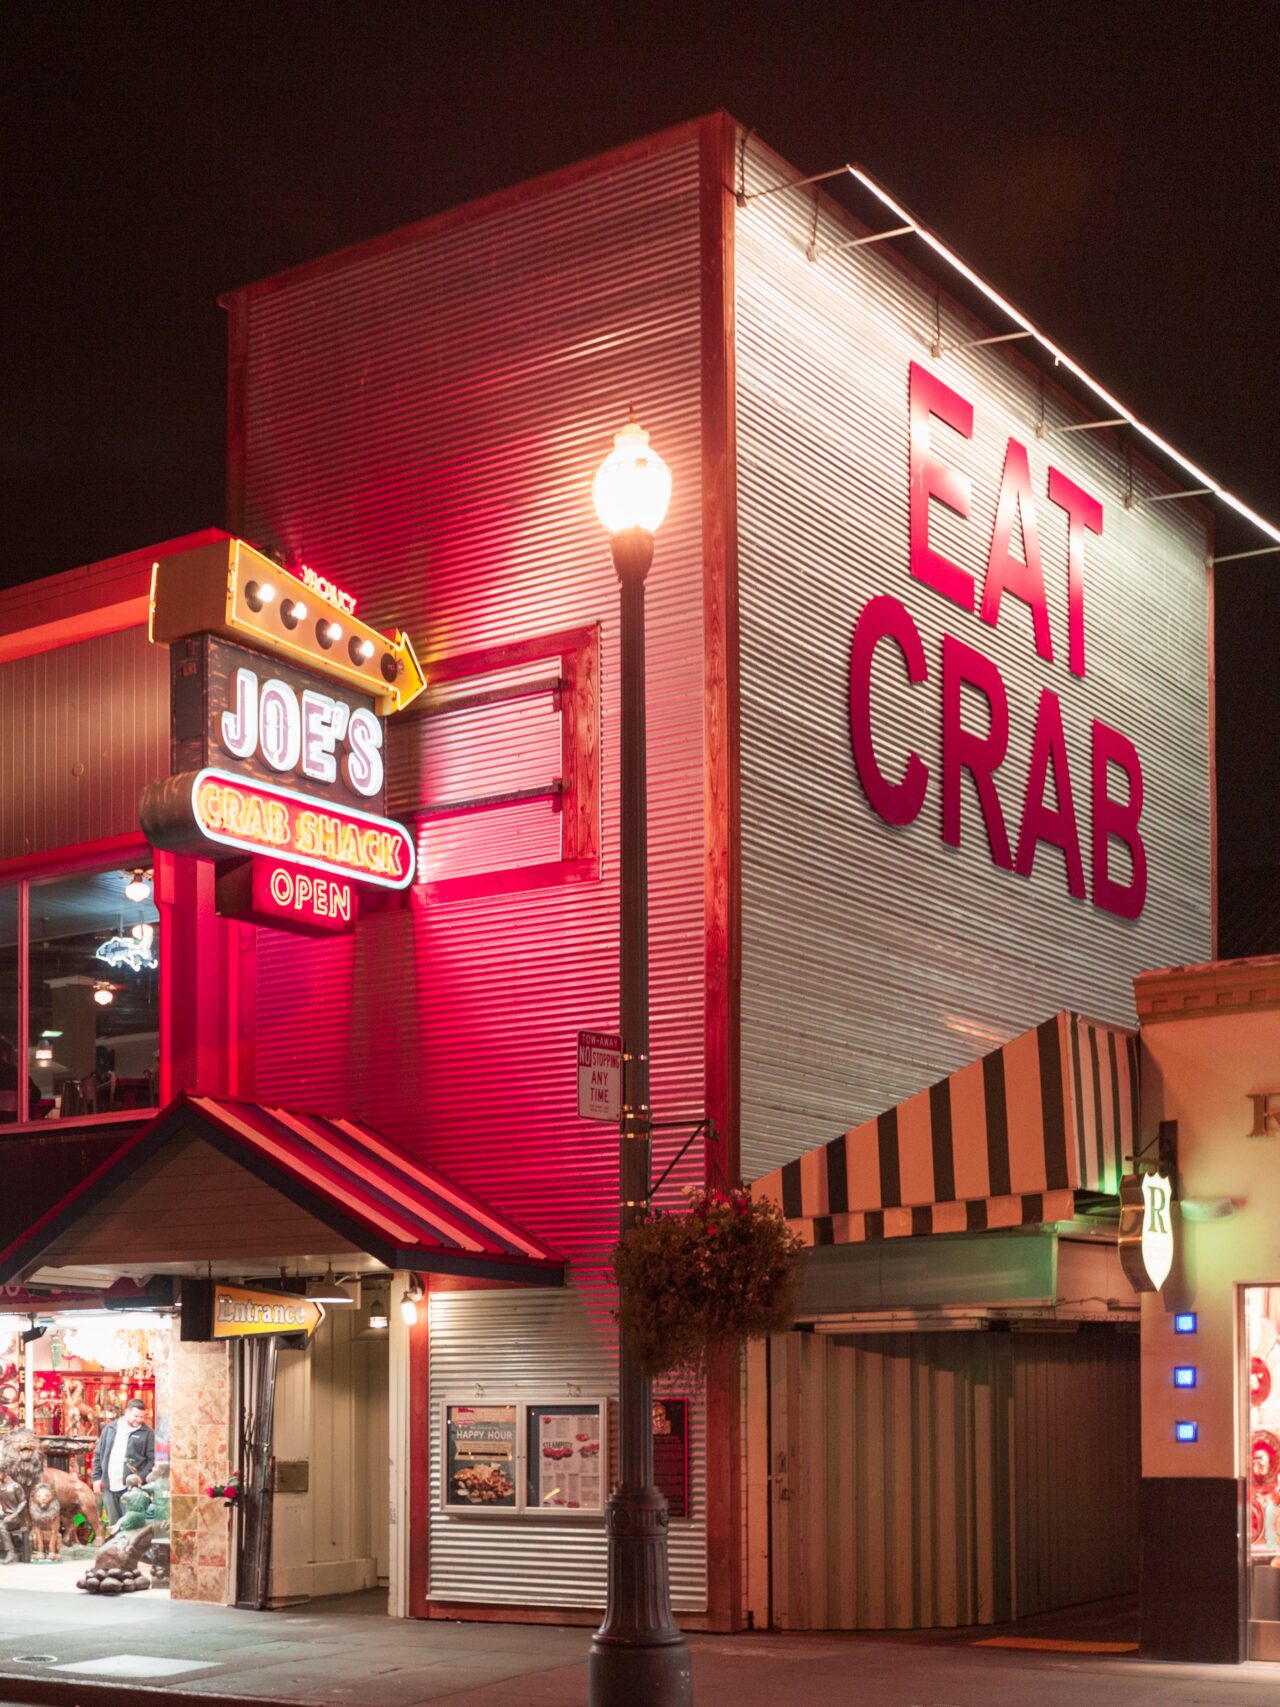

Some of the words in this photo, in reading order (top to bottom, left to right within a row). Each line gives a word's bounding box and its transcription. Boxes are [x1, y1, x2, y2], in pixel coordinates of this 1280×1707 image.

[909, 359, 1104, 679] EAT
[221, 667, 385, 797] JOE'S
[848, 594, 1149, 922] CRAB
[196, 782, 292, 847] CRAB
[294, 809, 405, 877] SHACK
[270, 867, 352, 922] OPEN
[580, 1045, 592, 1066] NO
[592, 1051, 620, 1070] STOPPING
[581, 1032, 619, 1050] TOW-AWAY
[590, 1087, 609, 1104] TIME
[591, 1070, 609, 1086] ANY
[1147, 1185, 1168, 1234] R
[217, 1294, 307, 1326] Entrance
[456, 1430, 485, 1440] HAPPY
[487, 1431, 513, 1441] HOUR
